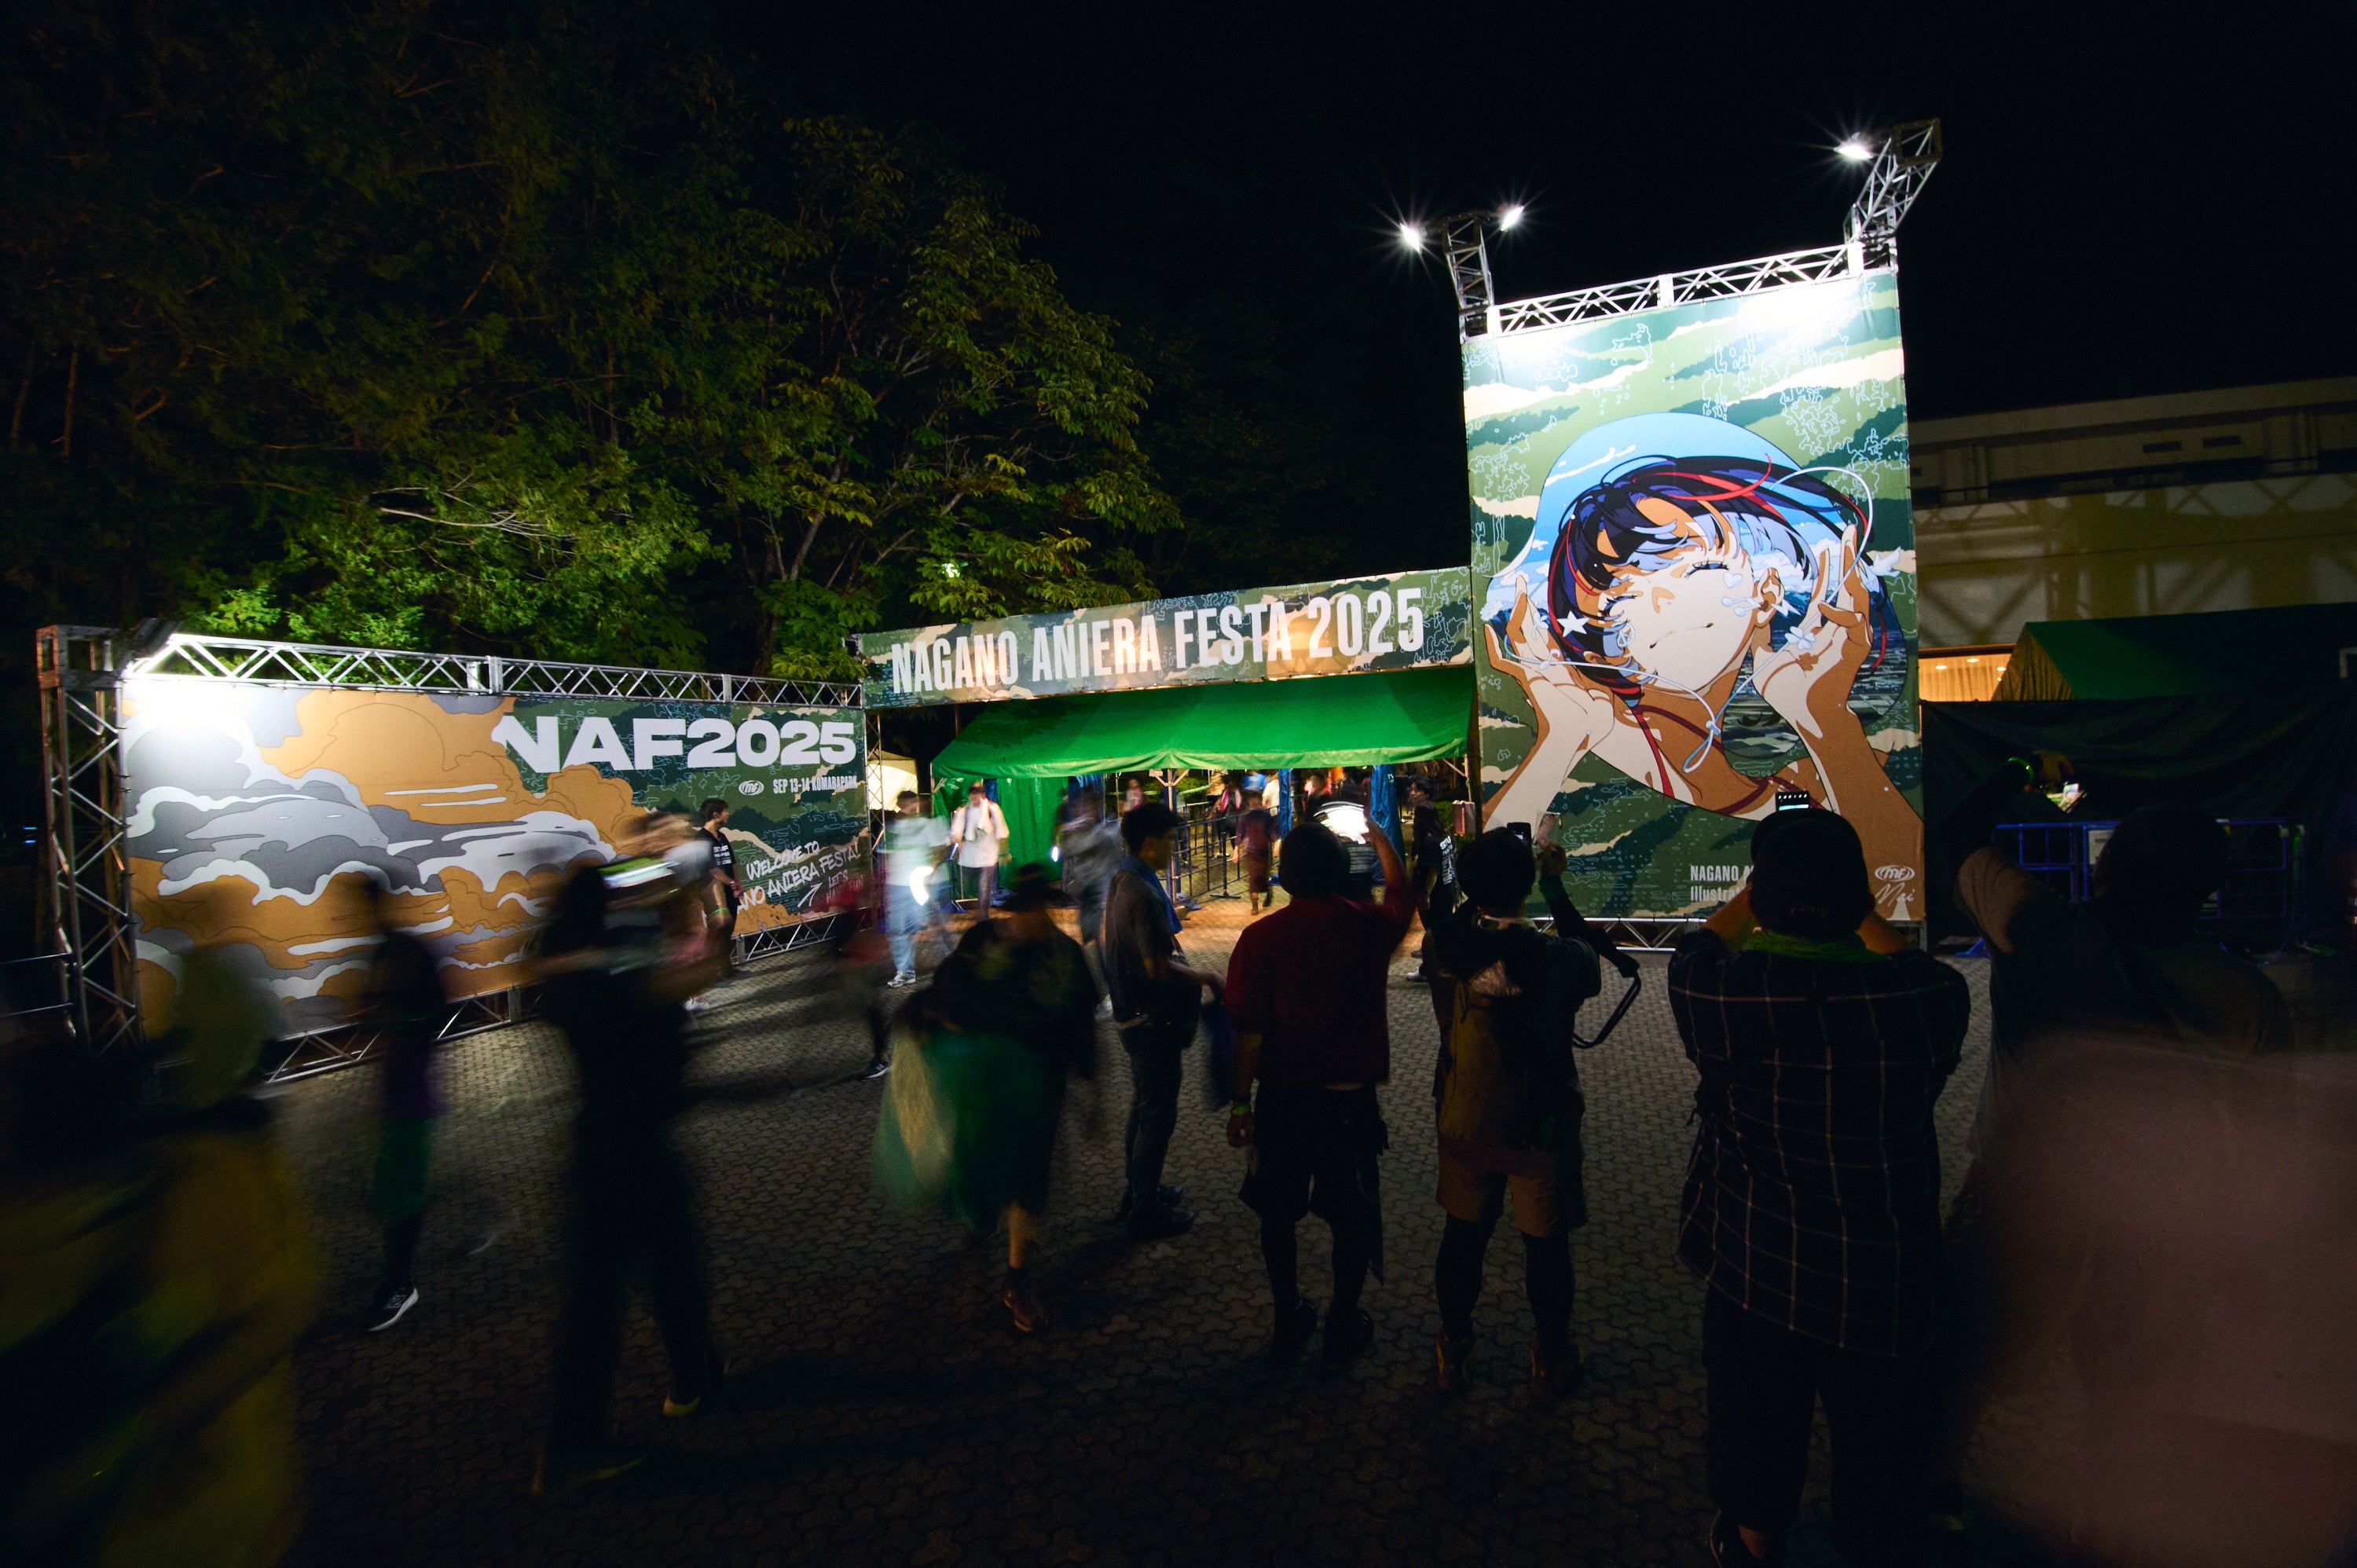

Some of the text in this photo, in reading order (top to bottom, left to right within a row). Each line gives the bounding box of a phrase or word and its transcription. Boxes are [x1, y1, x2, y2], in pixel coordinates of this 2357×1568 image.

[891, 587, 1424, 694] NAGANO ANIERA FESTA 2025
[491, 715, 857, 774] NAF2025
[772, 775, 858, 794] SEP 13-14 KOMABAPARK
[746, 847, 802, 881] WELCOME
[804, 840, 820, 859] TO
[766, 861, 820, 899] ANIERA
[818, 842, 862, 874] FESTA!
[1690, 865, 1739, 881] NAGANO
